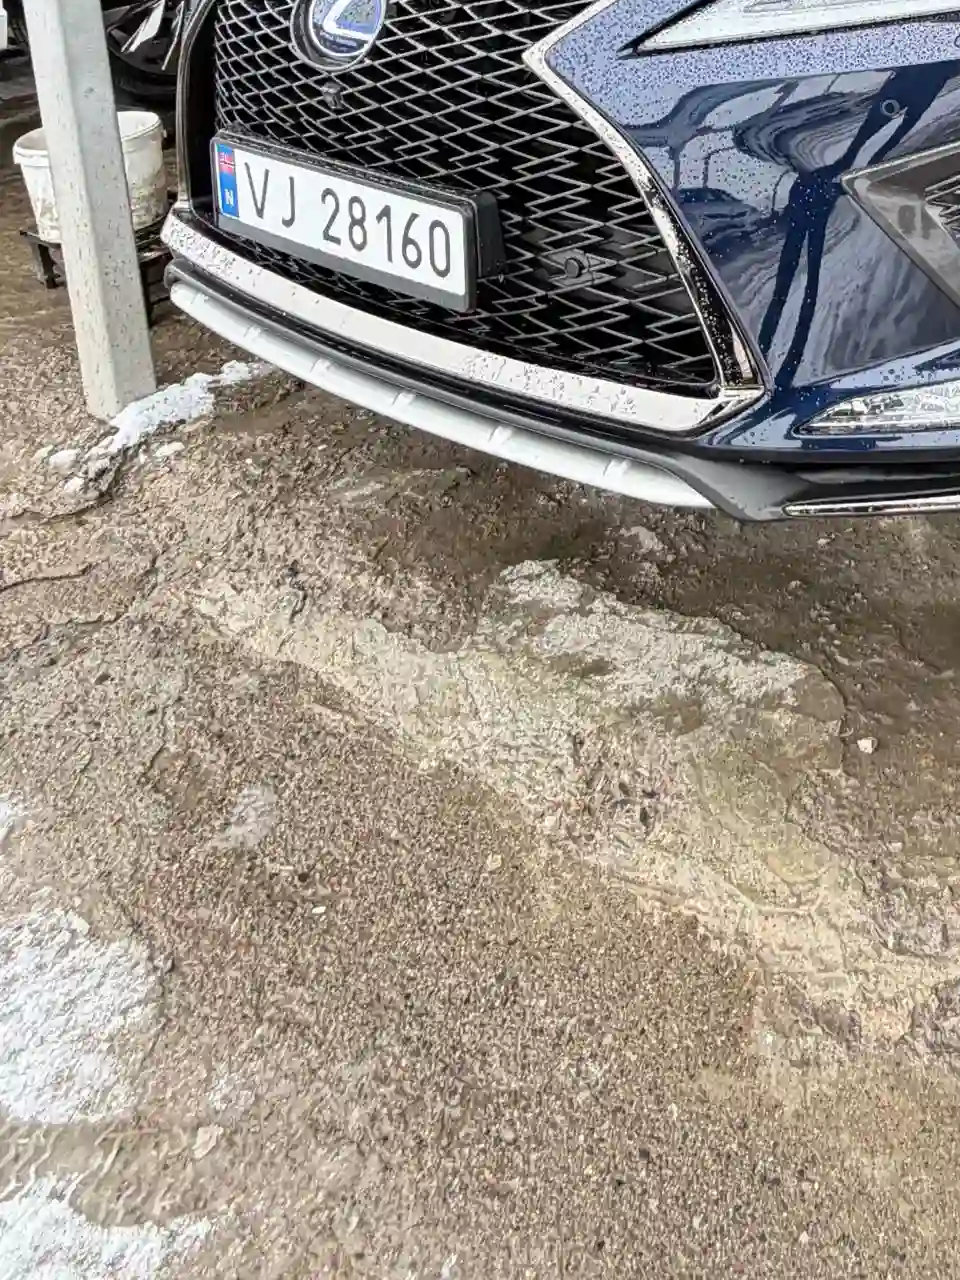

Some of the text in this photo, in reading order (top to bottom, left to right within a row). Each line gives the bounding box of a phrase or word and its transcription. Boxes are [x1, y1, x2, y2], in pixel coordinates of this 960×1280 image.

[224, 188, 235, 208] N
[244, 161, 451, 278] VJ 28160
